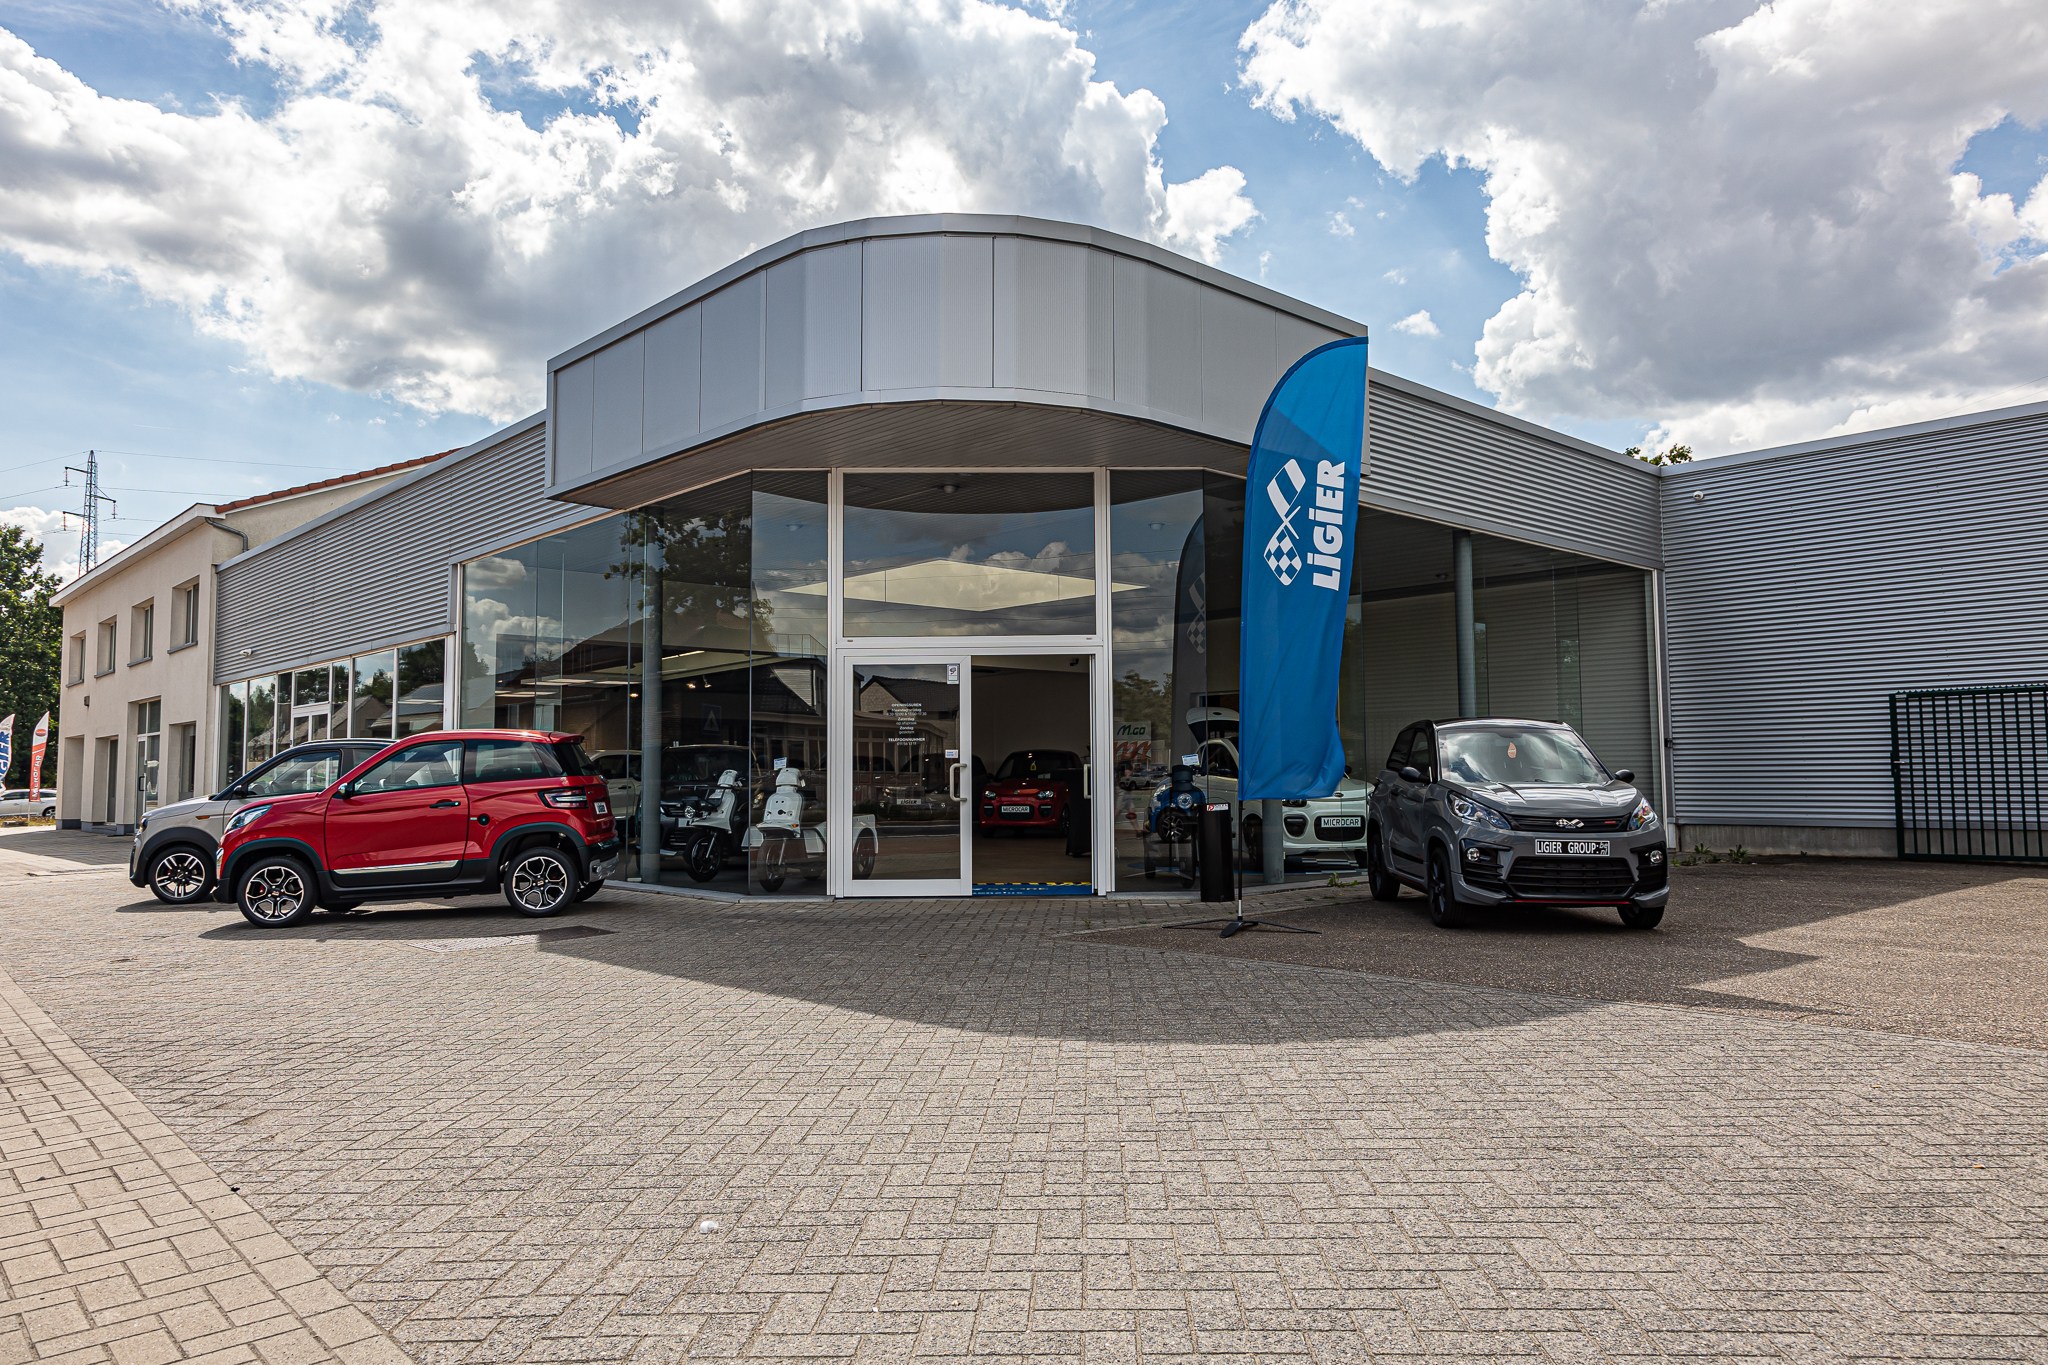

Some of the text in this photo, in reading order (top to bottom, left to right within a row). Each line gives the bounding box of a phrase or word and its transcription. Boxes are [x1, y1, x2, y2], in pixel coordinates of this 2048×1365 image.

[1117, 725, 1146, 735] M.GO
[1323, 818, 1360, 826] MICROCAR
[1537, 842, 1562, 853] LIGIER
